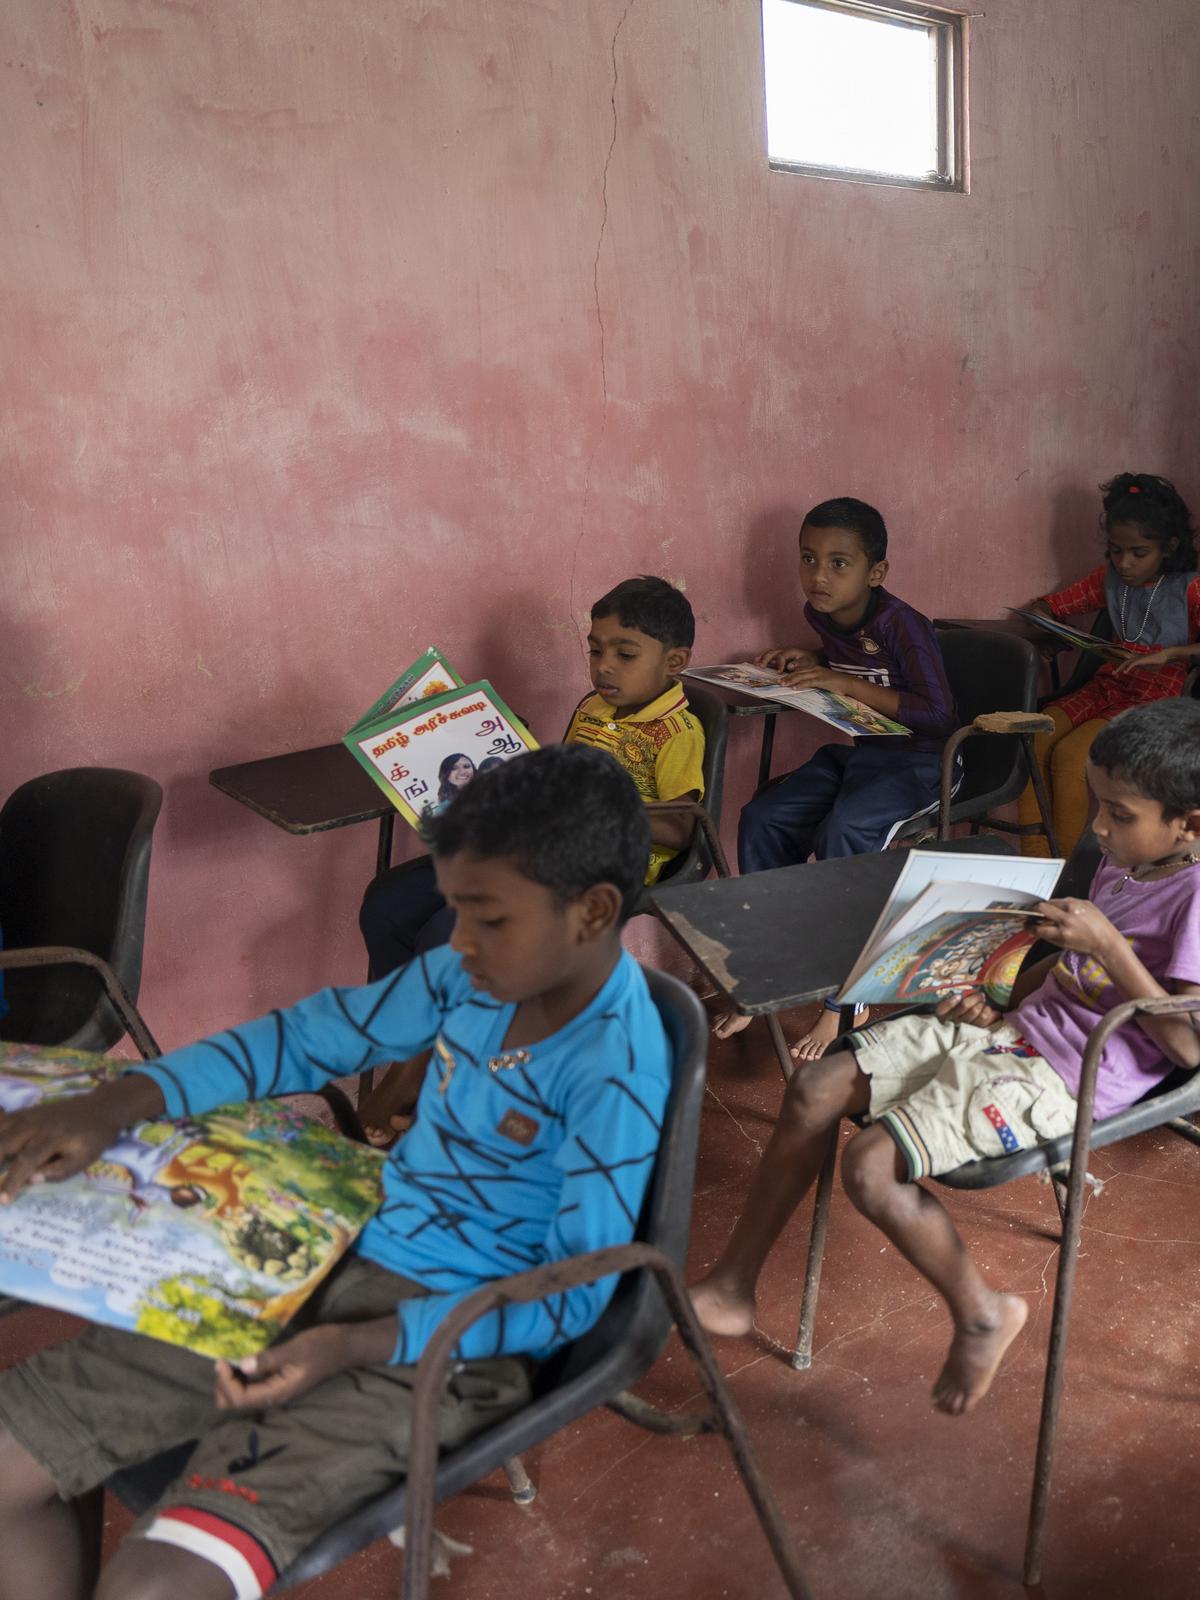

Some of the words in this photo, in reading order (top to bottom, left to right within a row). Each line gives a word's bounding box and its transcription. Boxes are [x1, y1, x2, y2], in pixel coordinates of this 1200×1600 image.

[475, 715, 505, 737] அ
[371, 731, 409, 759] தமிழ்
[486, 734, 522, 755] ஆ
[390, 763, 410, 781] க்
